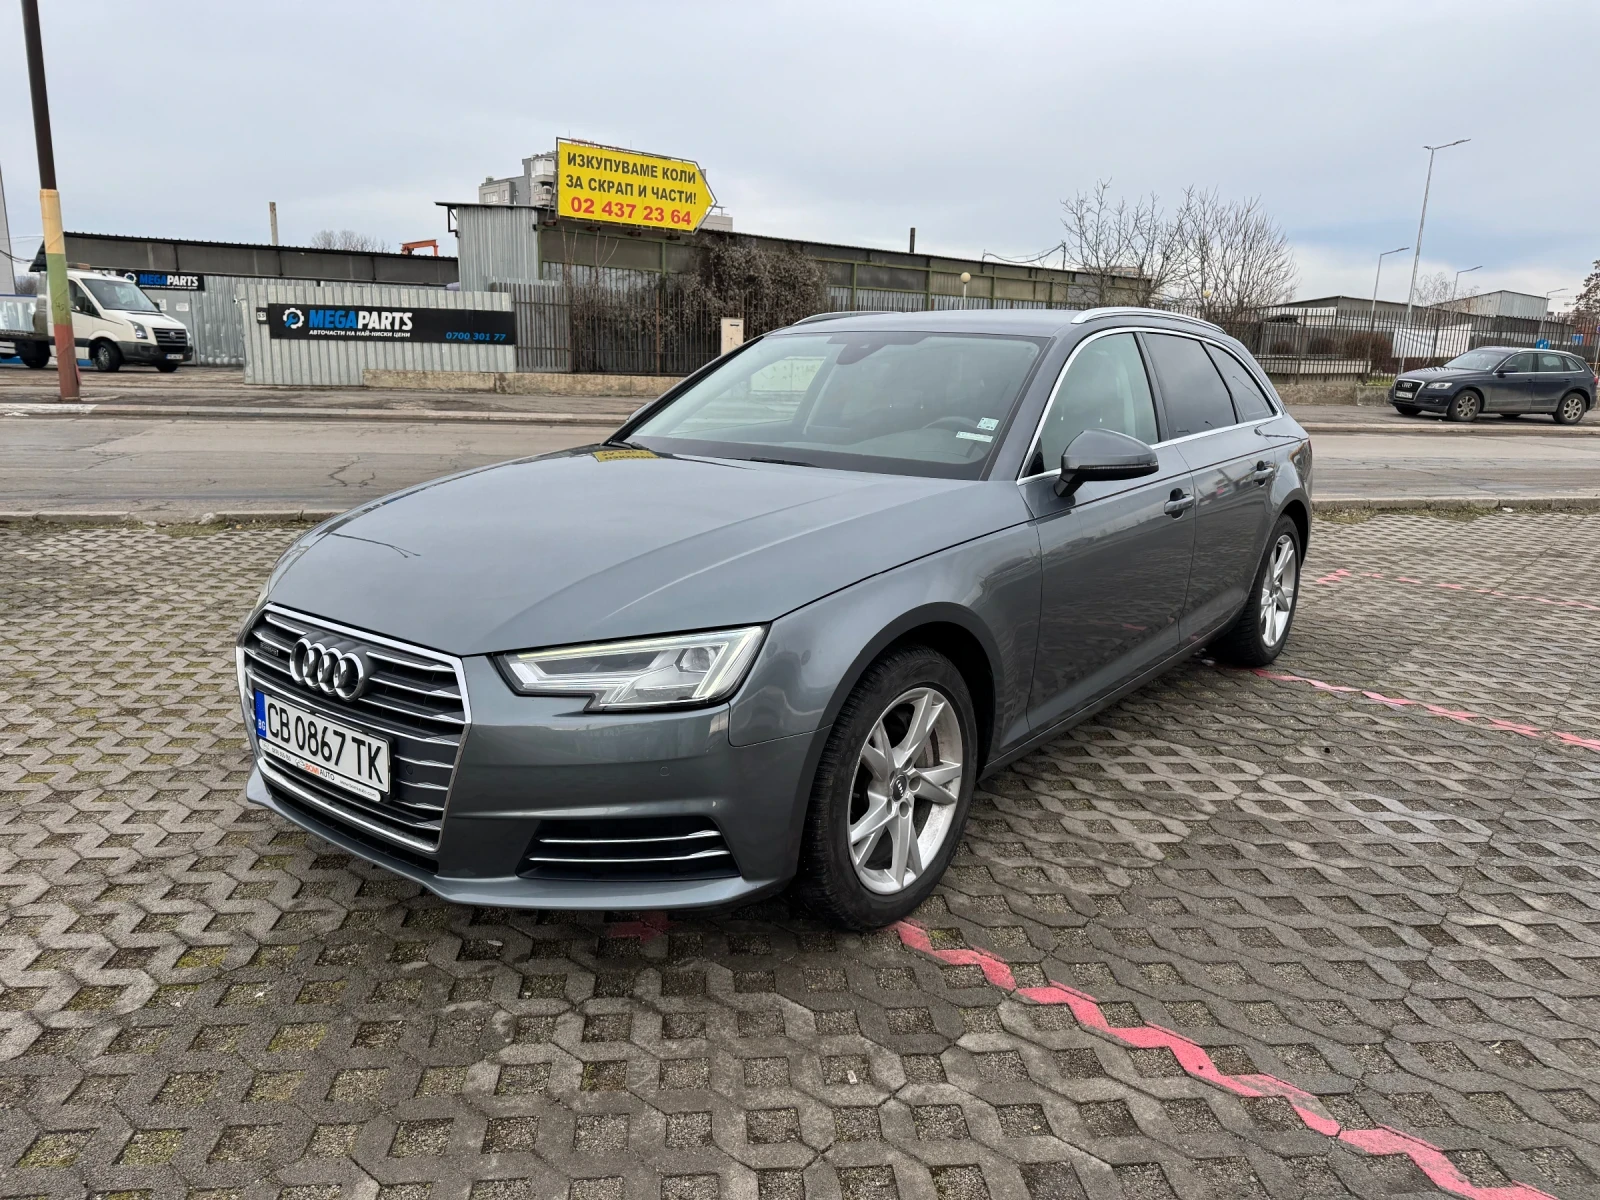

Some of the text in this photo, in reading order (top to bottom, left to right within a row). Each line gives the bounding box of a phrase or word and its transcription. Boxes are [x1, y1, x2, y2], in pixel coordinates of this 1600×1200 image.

[567, 152, 696, 184] ИЗКУПУВАМЕ КОЛИ
[566, 174, 697, 205] ЗА СКРАП И ЧАСТИ!
[570, 196, 692, 225] 02 437 23 64
[139, 273, 199, 286] MEGAPARTS
[309, 309, 413, 330] MEGAPARTS
[446, 331, 506, 341] 0700 301 77
[257, 718, 267, 731] BG
[295, 715, 346, 767] 0867
[351, 736, 384, 785] TK
